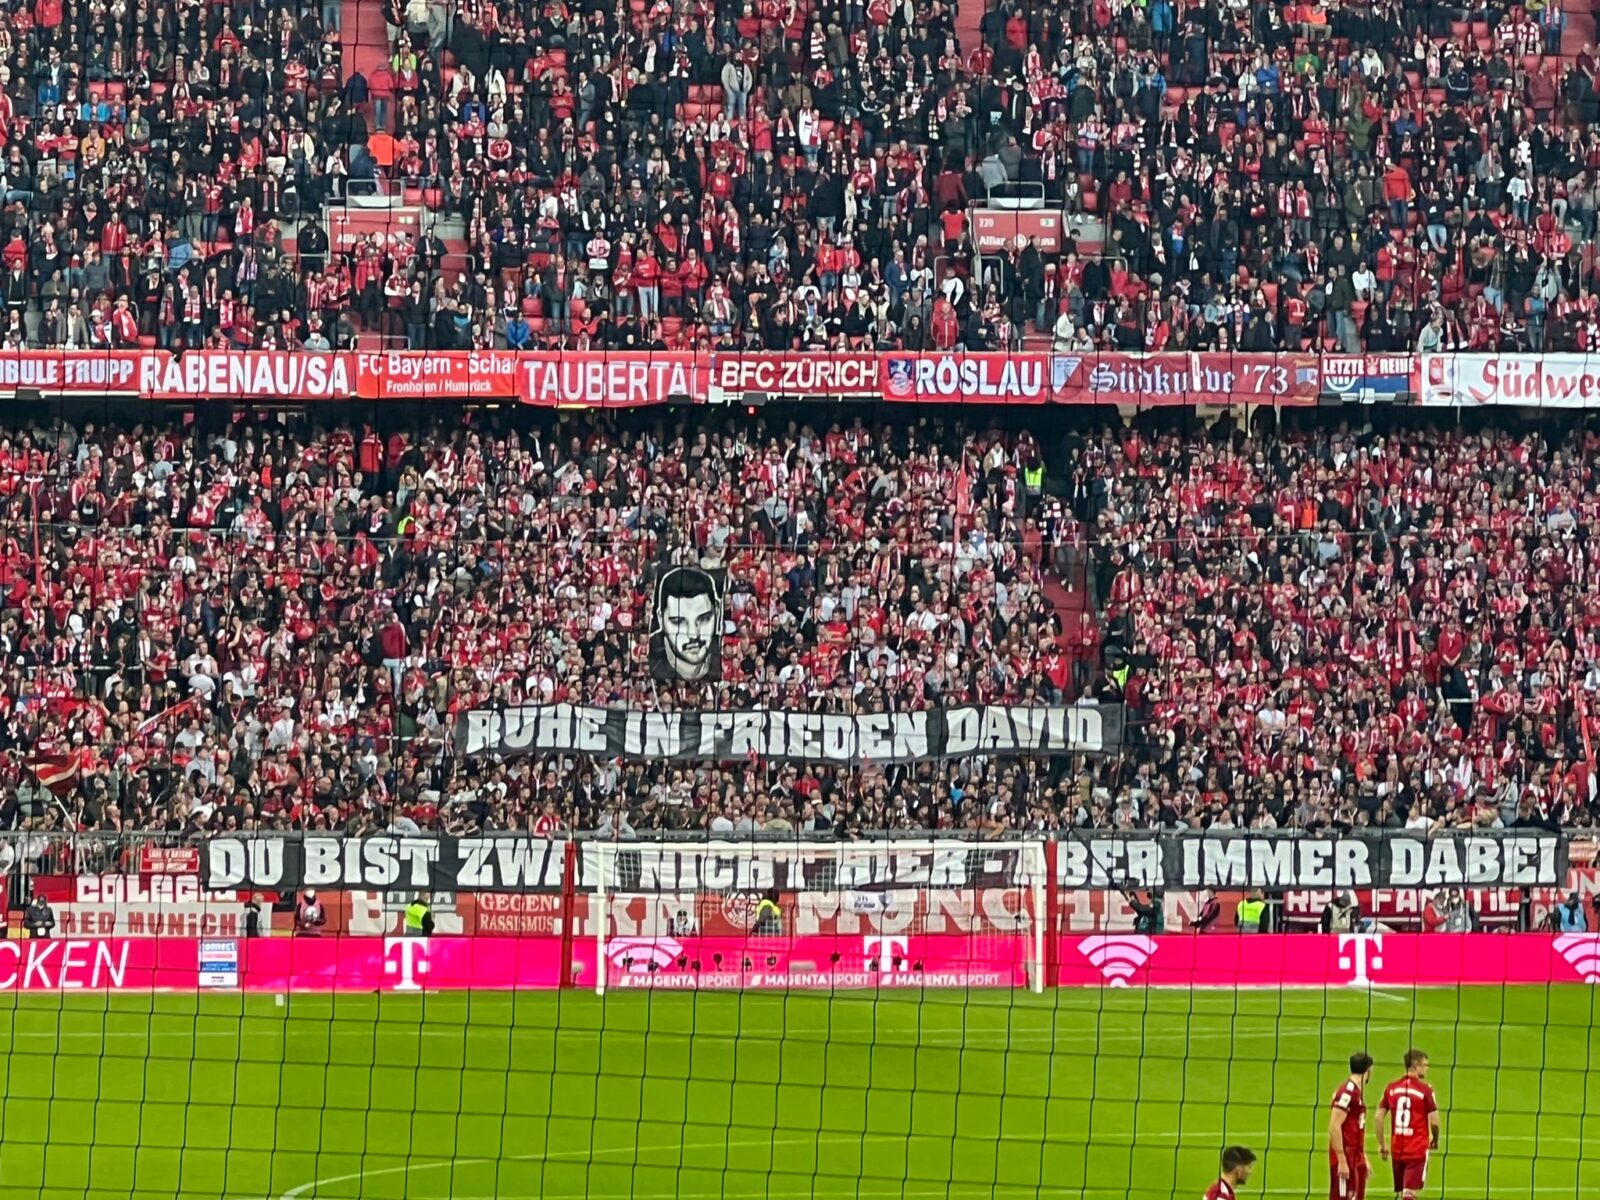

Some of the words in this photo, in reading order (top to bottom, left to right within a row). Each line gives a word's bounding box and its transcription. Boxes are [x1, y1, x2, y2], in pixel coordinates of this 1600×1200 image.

[979, 218, 994, 228] 220
[64, 359, 134, 384] TRUPP
[140, 355, 349, 396] RABENAU/SA
[358, 354, 382, 376] FC
[388, 352, 451, 380] Bayern
[468, 352, 518, 375] Scha
[721, 360, 774, 388] BFC
[778, 357, 879, 389] ZÜRICH
[916, 355, 1042, 397] RÖSLAU
[1322, 358, 1365, 375] LETZTE
[386, 380, 437, 393] Fronhofen
[444, 380, 492, 393] Hunsrück
[466, 702, 607, 755] RUHE
[624, 711, 681, 756] IN
[698, 710, 929, 760] FRIEDEN
[945, 704, 1103, 753] DAVID
[208, 837, 284, 889] DU
[303, 837, 440, 887] BIST
[456, 837, 621, 887] ZWAR
[639, 839, 817, 889] NICHT
[1182, 838, 1372, 887] IMMER
[1389, 837, 1557, 885] DABEI
[76, 874, 237, 904] COLEG
[480, 894, 553, 911] GEGEN
[60, 911, 114, 934] RED
[480, 914, 555, 933] RASSISMUS
[0, 941, 130, 989] CKEN
[634, 974, 695, 986] MAGENTA
[765, 974, 826, 986] MAGENTA
[895, 974, 957, 986] MAGENTA
